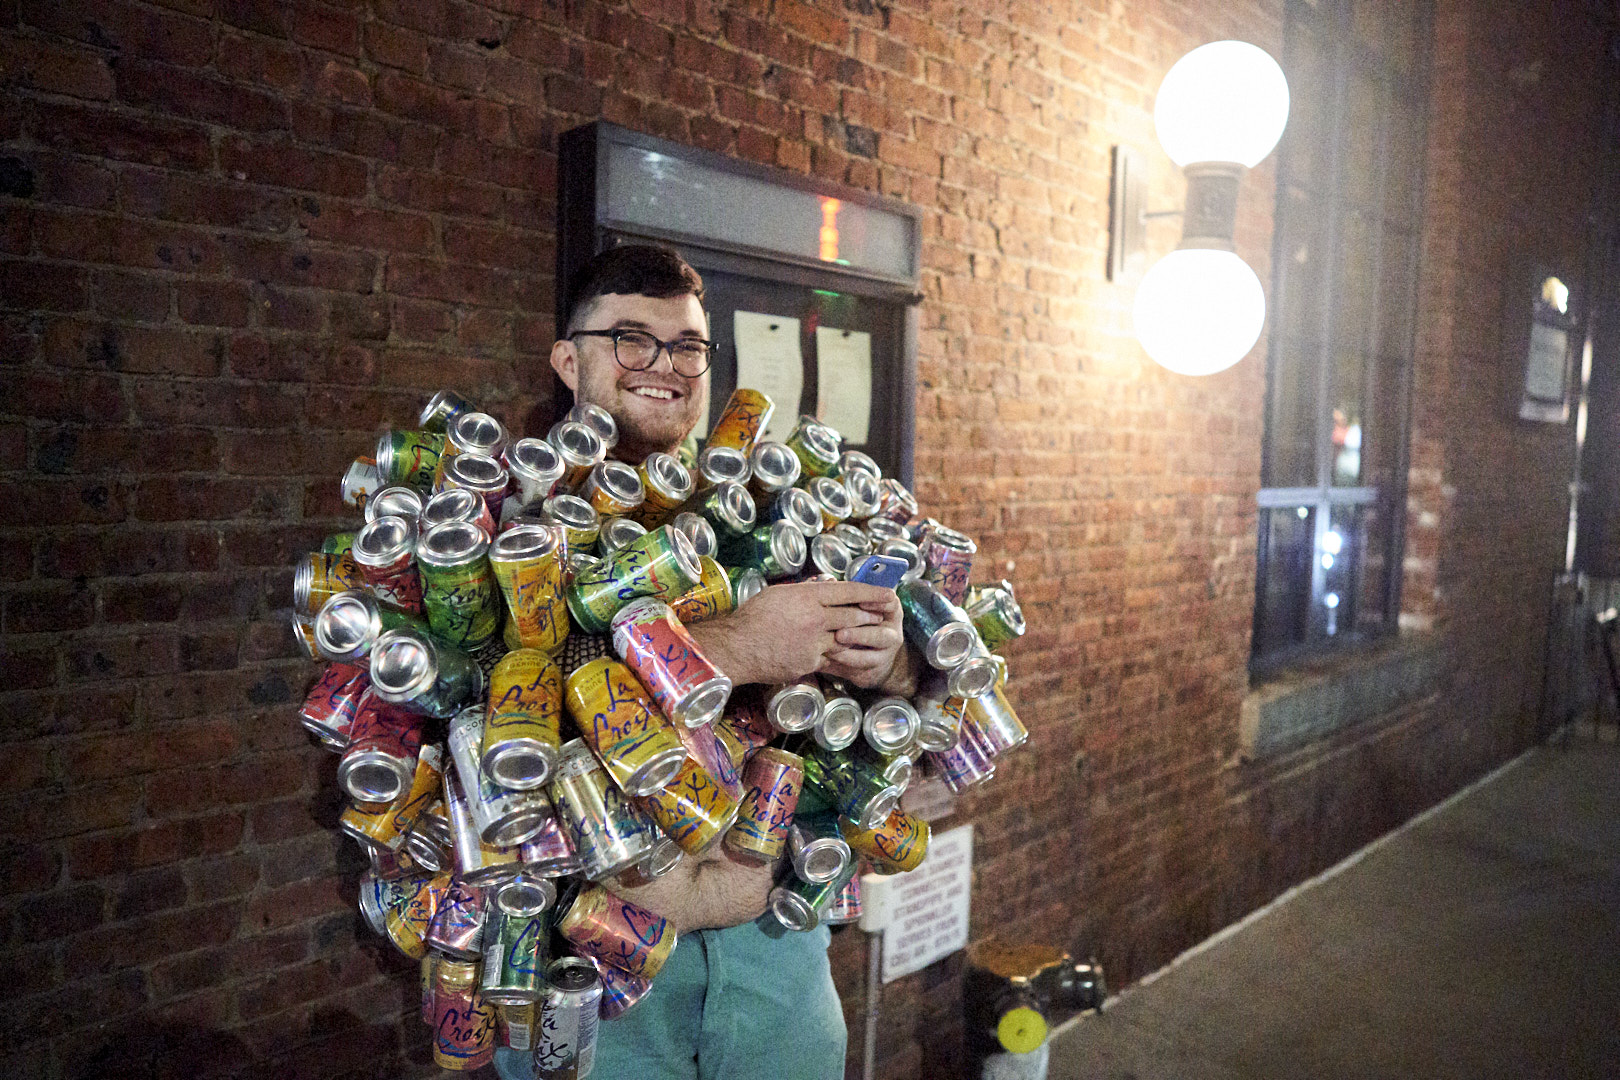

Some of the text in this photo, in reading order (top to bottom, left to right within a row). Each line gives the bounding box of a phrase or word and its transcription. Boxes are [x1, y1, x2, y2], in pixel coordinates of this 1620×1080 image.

[526, 662, 558, 694] La
[604, 667, 635, 713] La
[763, 765, 793, 806] La
[734, 786, 795, 833] Croix
[438, 1008, 497, 1049] Croix
